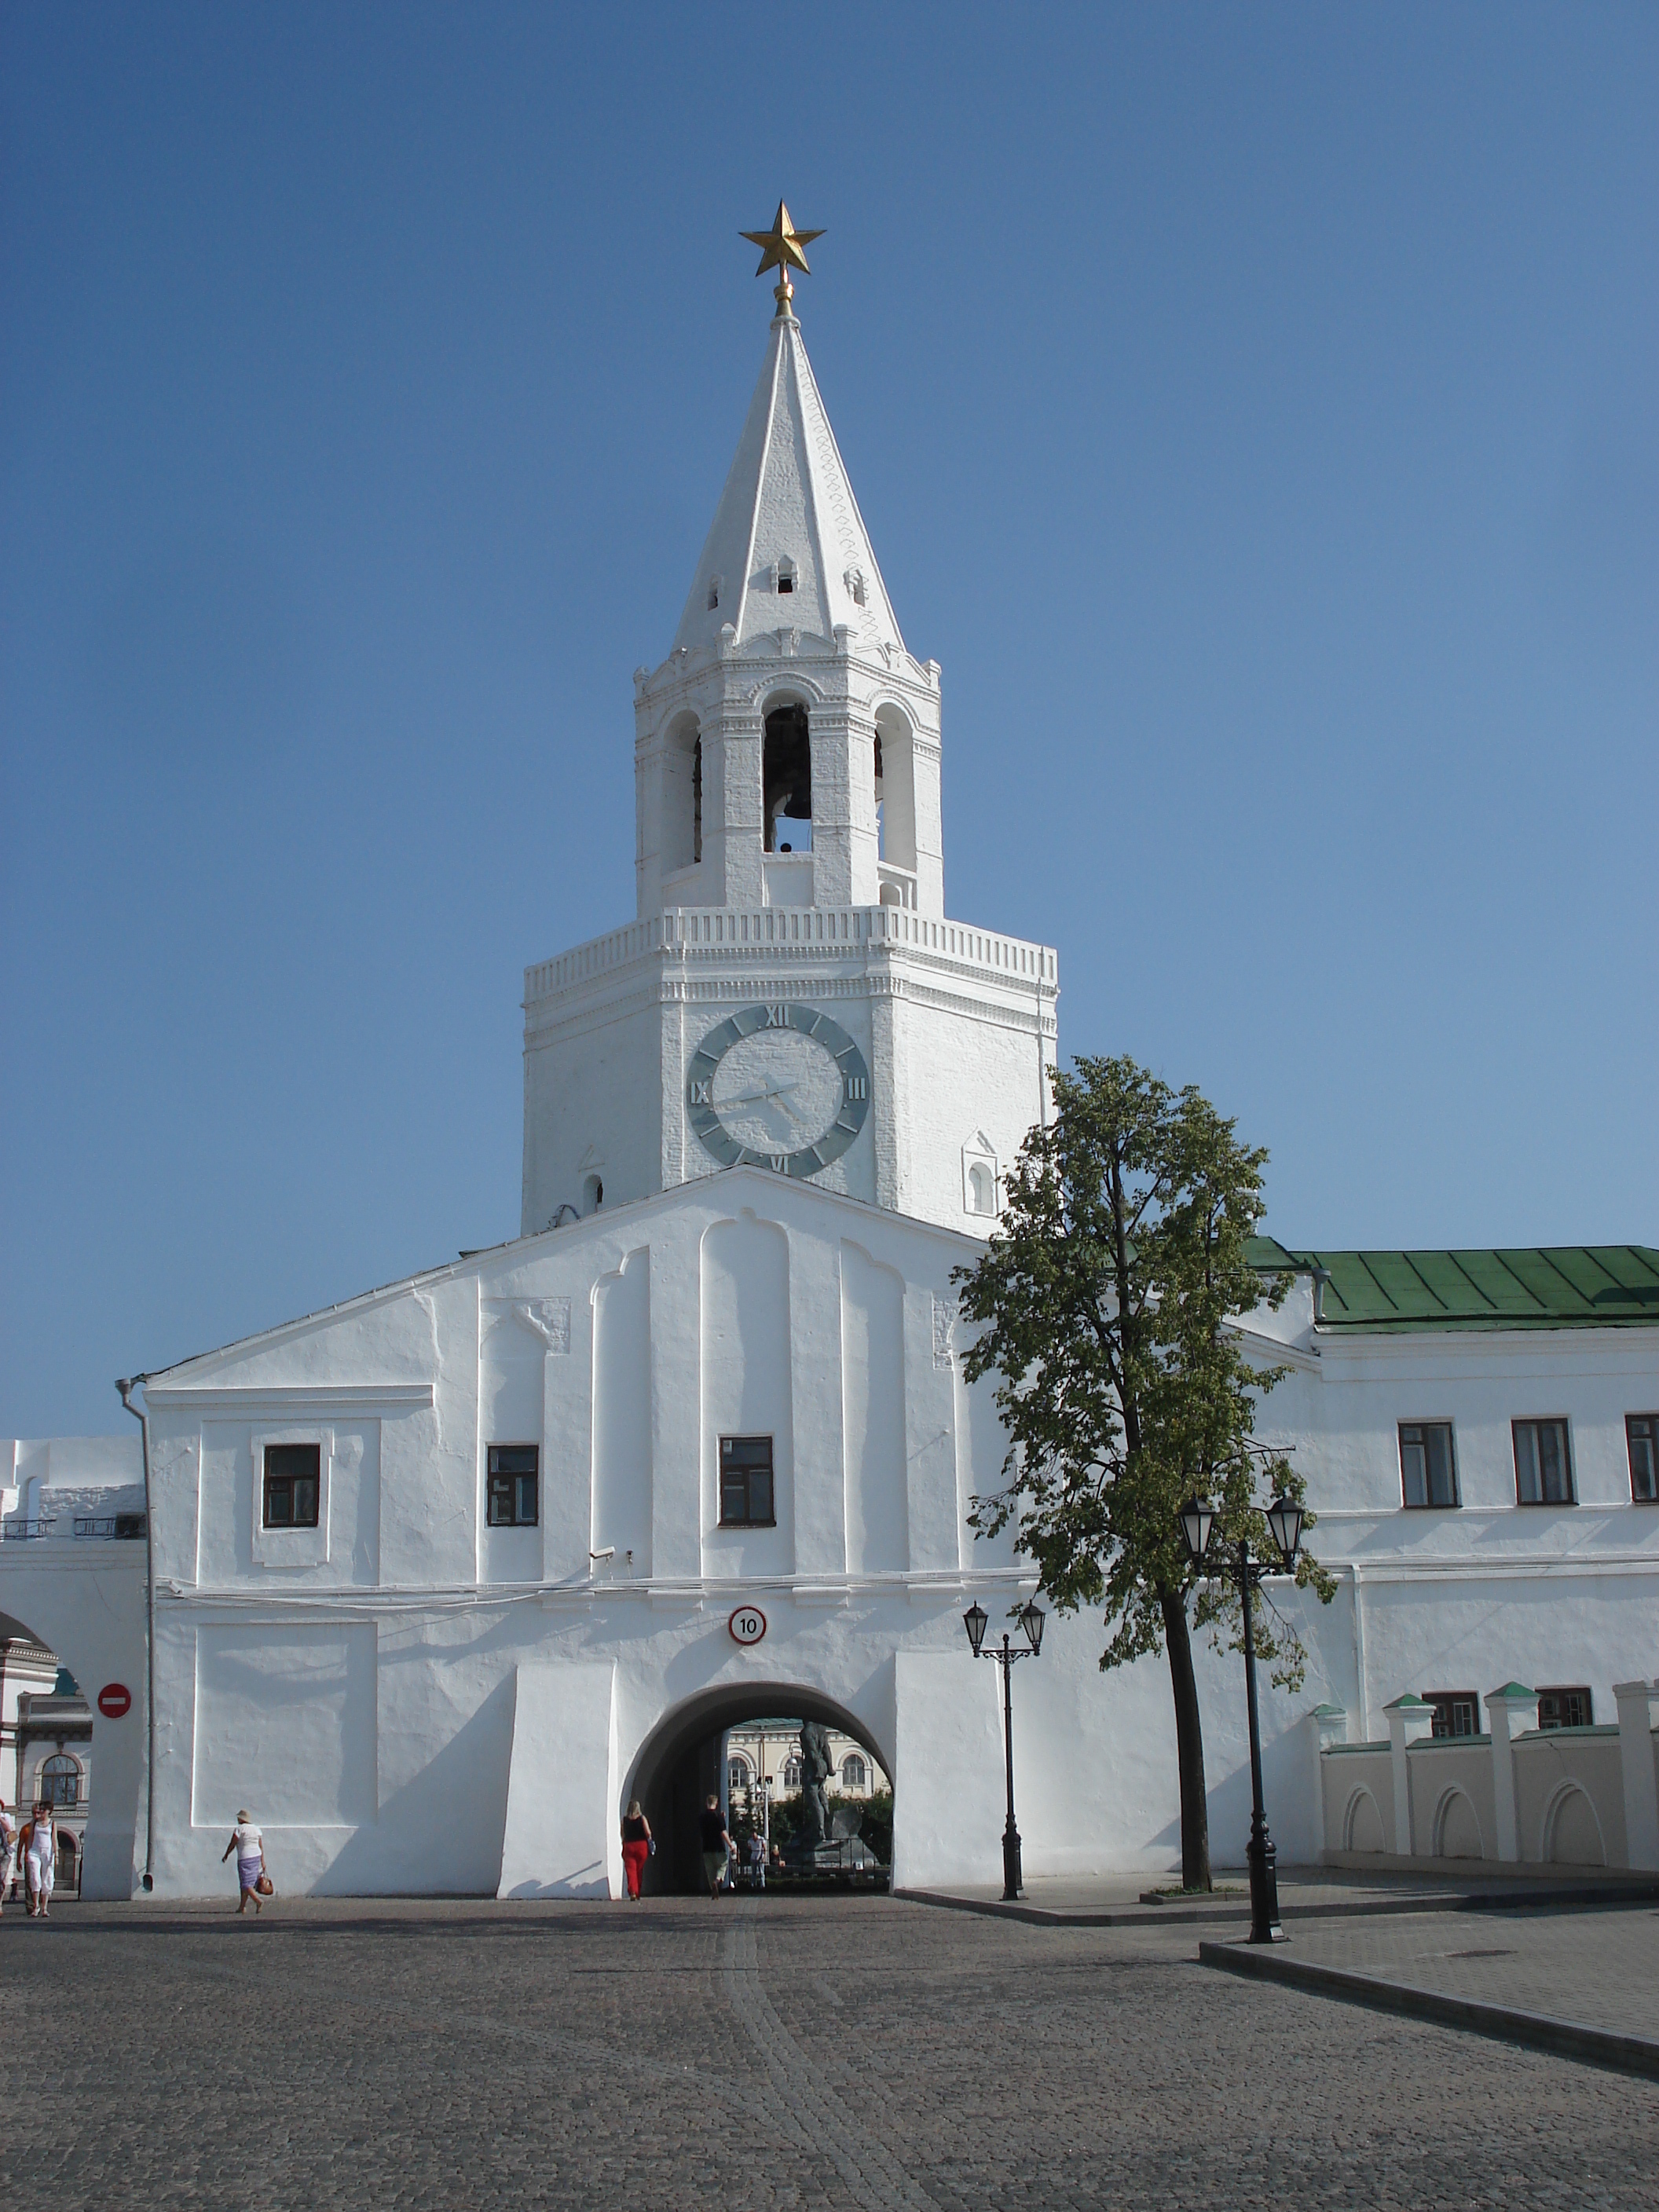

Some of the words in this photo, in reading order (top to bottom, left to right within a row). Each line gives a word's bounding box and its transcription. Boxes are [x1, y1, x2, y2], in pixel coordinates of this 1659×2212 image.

[765, 1005, 789, 1027] XII
[690, 1082, 709, 1104] IX
[848, 1077, 866, 1100] III
[770, 1155, 789, 1174] VI
[740, 1618, 757, 1634] 10
